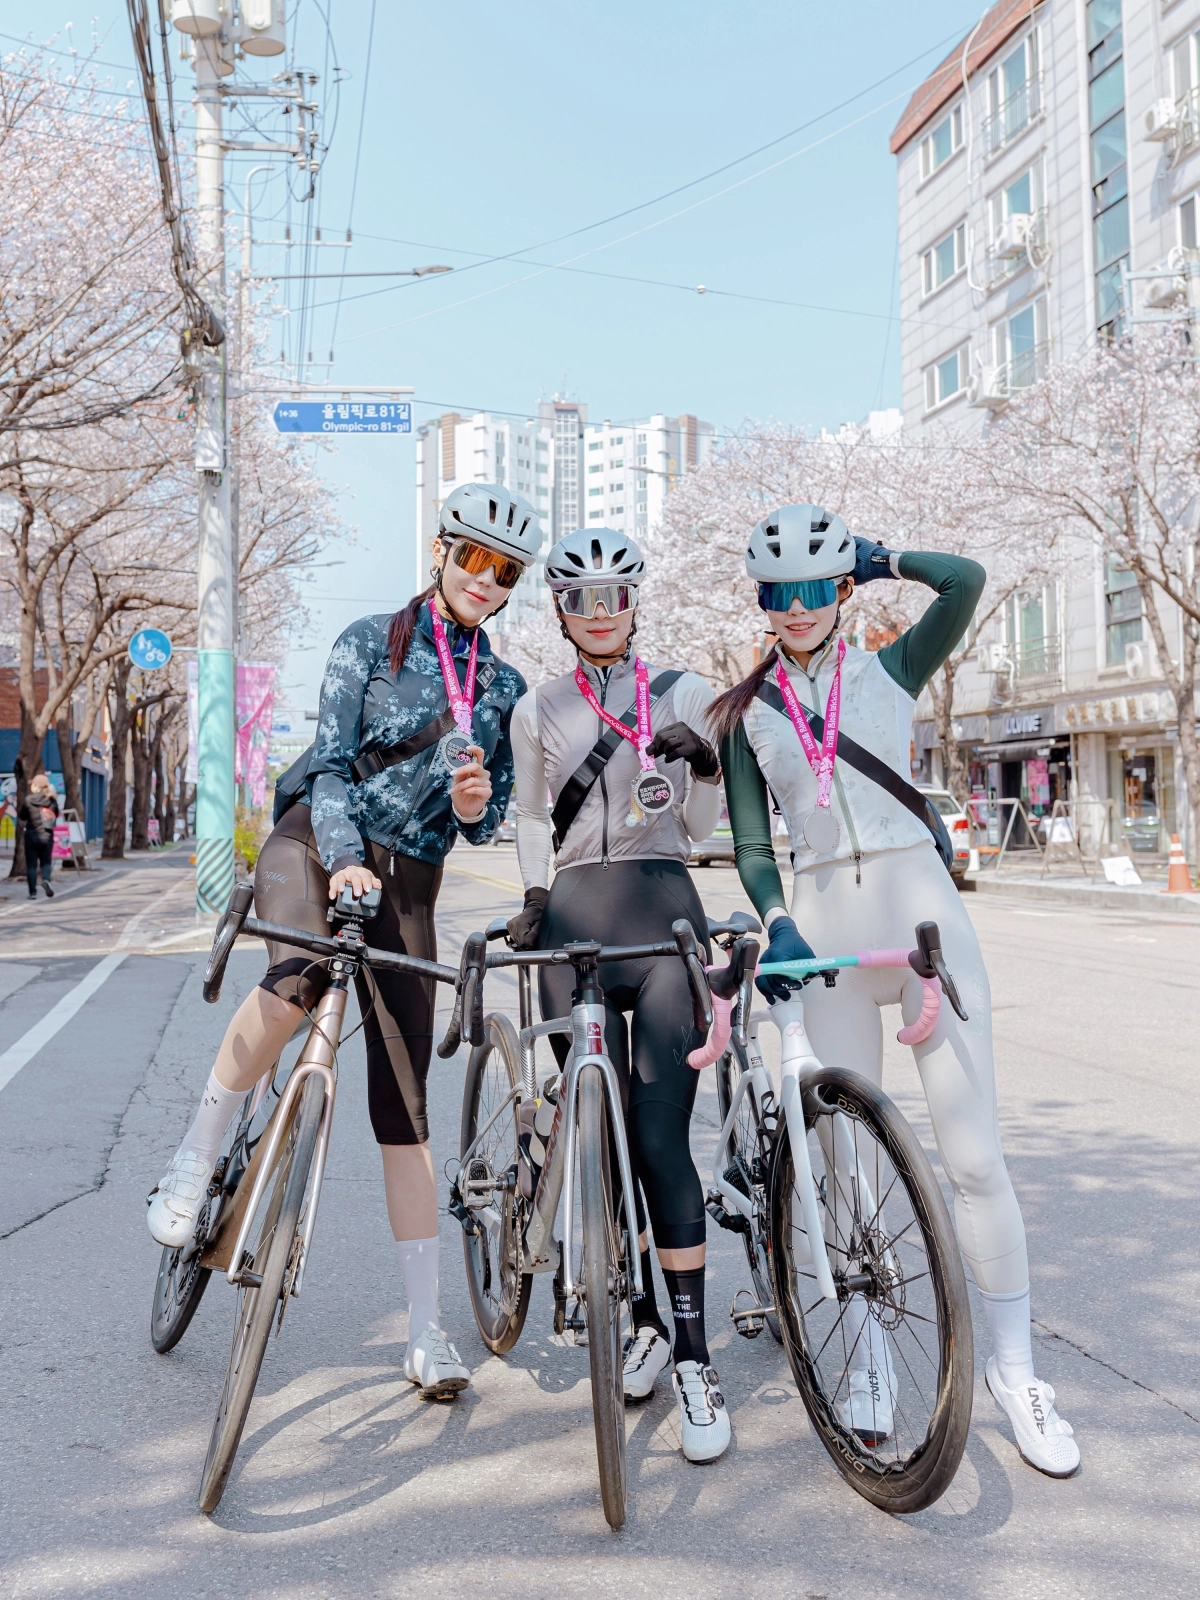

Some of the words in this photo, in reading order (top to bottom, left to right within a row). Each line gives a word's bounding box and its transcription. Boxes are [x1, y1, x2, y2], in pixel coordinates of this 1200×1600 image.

[322, 404, 410, 419] 올림픽로81길
[322, 421, 379, 432] Olympic-ro
[380, 422, 409, 432] 81-gil
[827, 711, 836, 728] 라이딩
[796, 716, 807, 732] 라이딩
[802, 732, 814, 750] 챌린지
[825, 729, 834, 747] 챌린지
[782, 957, 836, 969] WIAWIS
[837, 1097, 879, 1133] DRIVE
[675, 1294, 691, 1302] FOR
[676, 1303, 691, 1311] THE
[824, 1426, 866, 1474] DRIVE
